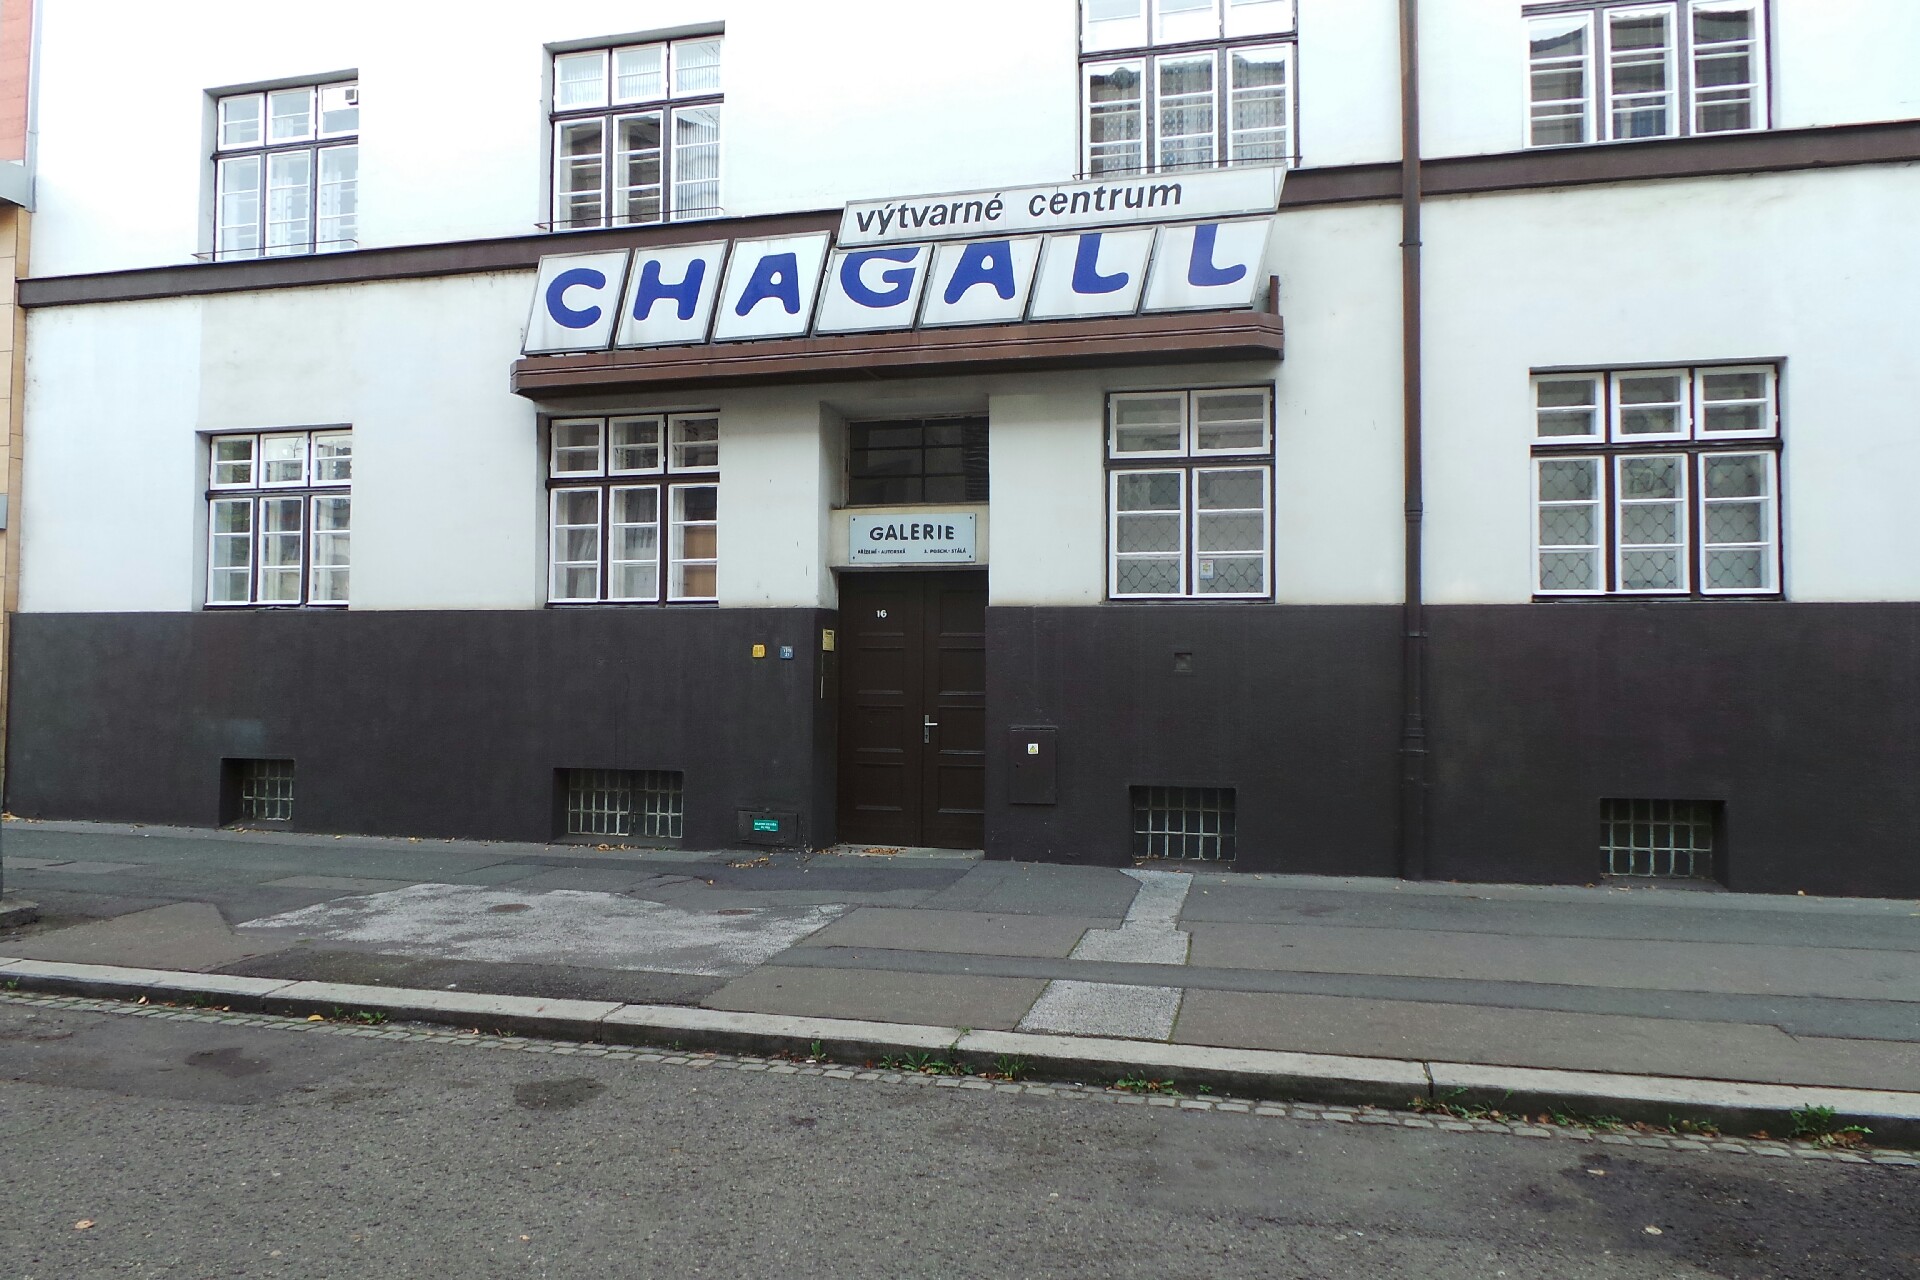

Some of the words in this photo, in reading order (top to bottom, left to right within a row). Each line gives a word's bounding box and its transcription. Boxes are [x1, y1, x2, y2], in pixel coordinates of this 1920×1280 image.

[857, 193, 1004, 235] výtvarné
[1028, 183, 1183, 218] centrum
[545, 224, 1248, 329] CHAGALL
[869, 523, 955, 541] GALERIE
[876, 609, 887, 618] 16
